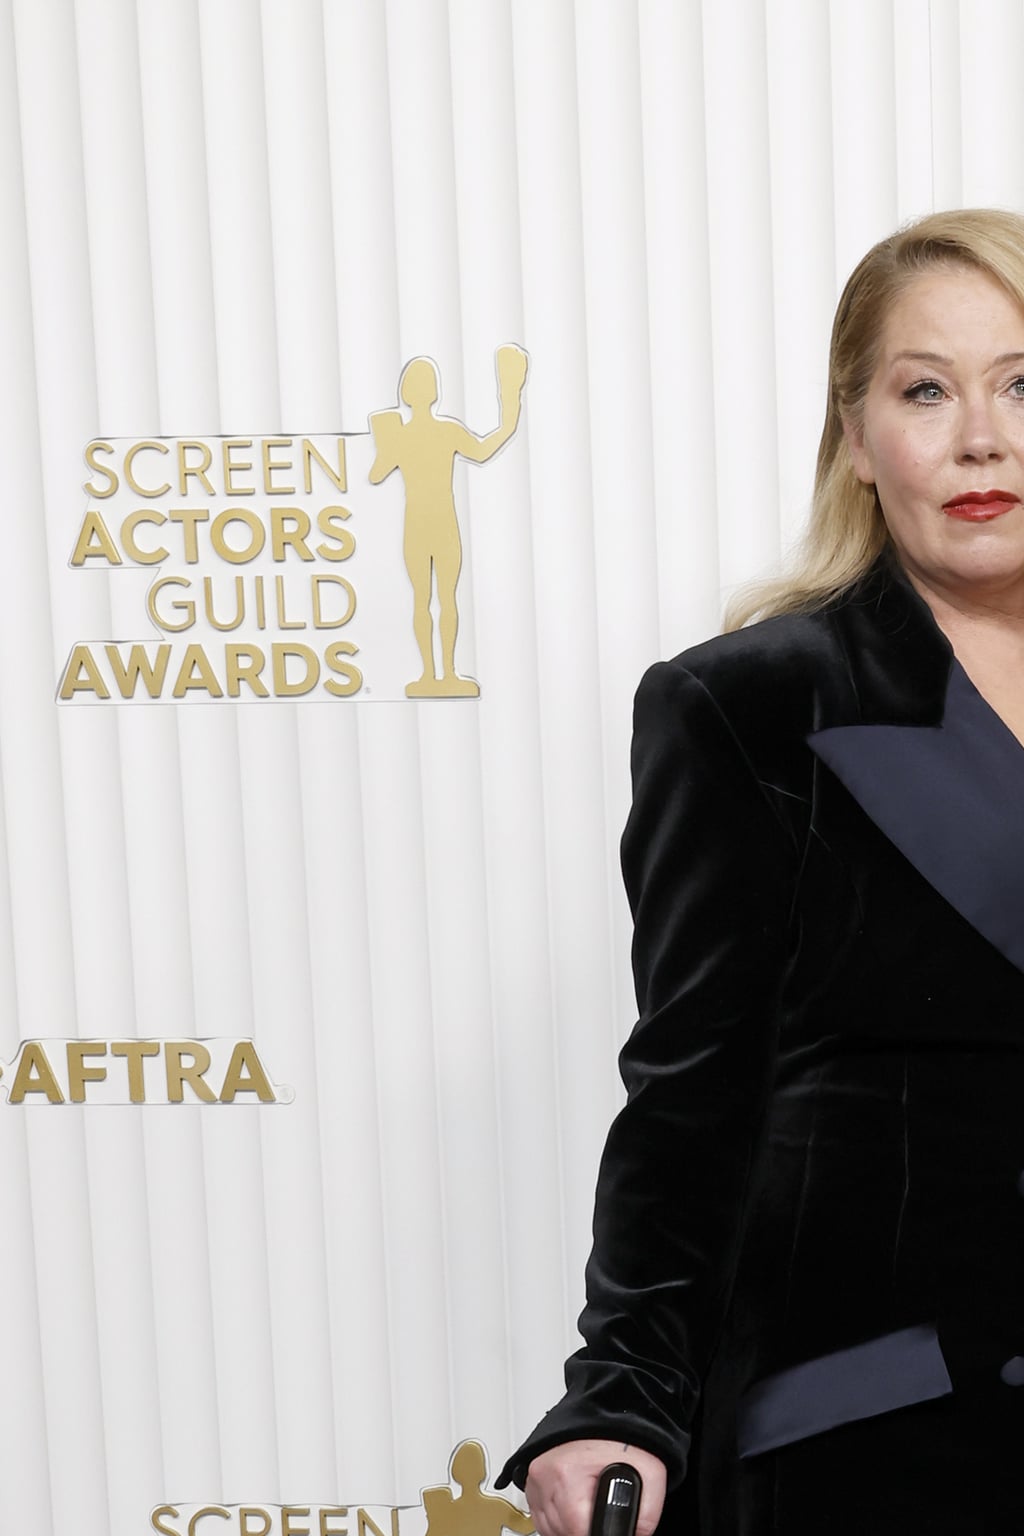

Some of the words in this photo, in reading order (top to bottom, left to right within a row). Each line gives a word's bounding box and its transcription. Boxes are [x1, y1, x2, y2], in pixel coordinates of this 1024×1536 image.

[84, 438, 349, 498] SCREEN
[71, 505, 356, 566] ACTORS
[147, 573, 357, 632] GUILD
[60, 641, 363, 700] AWARDS
